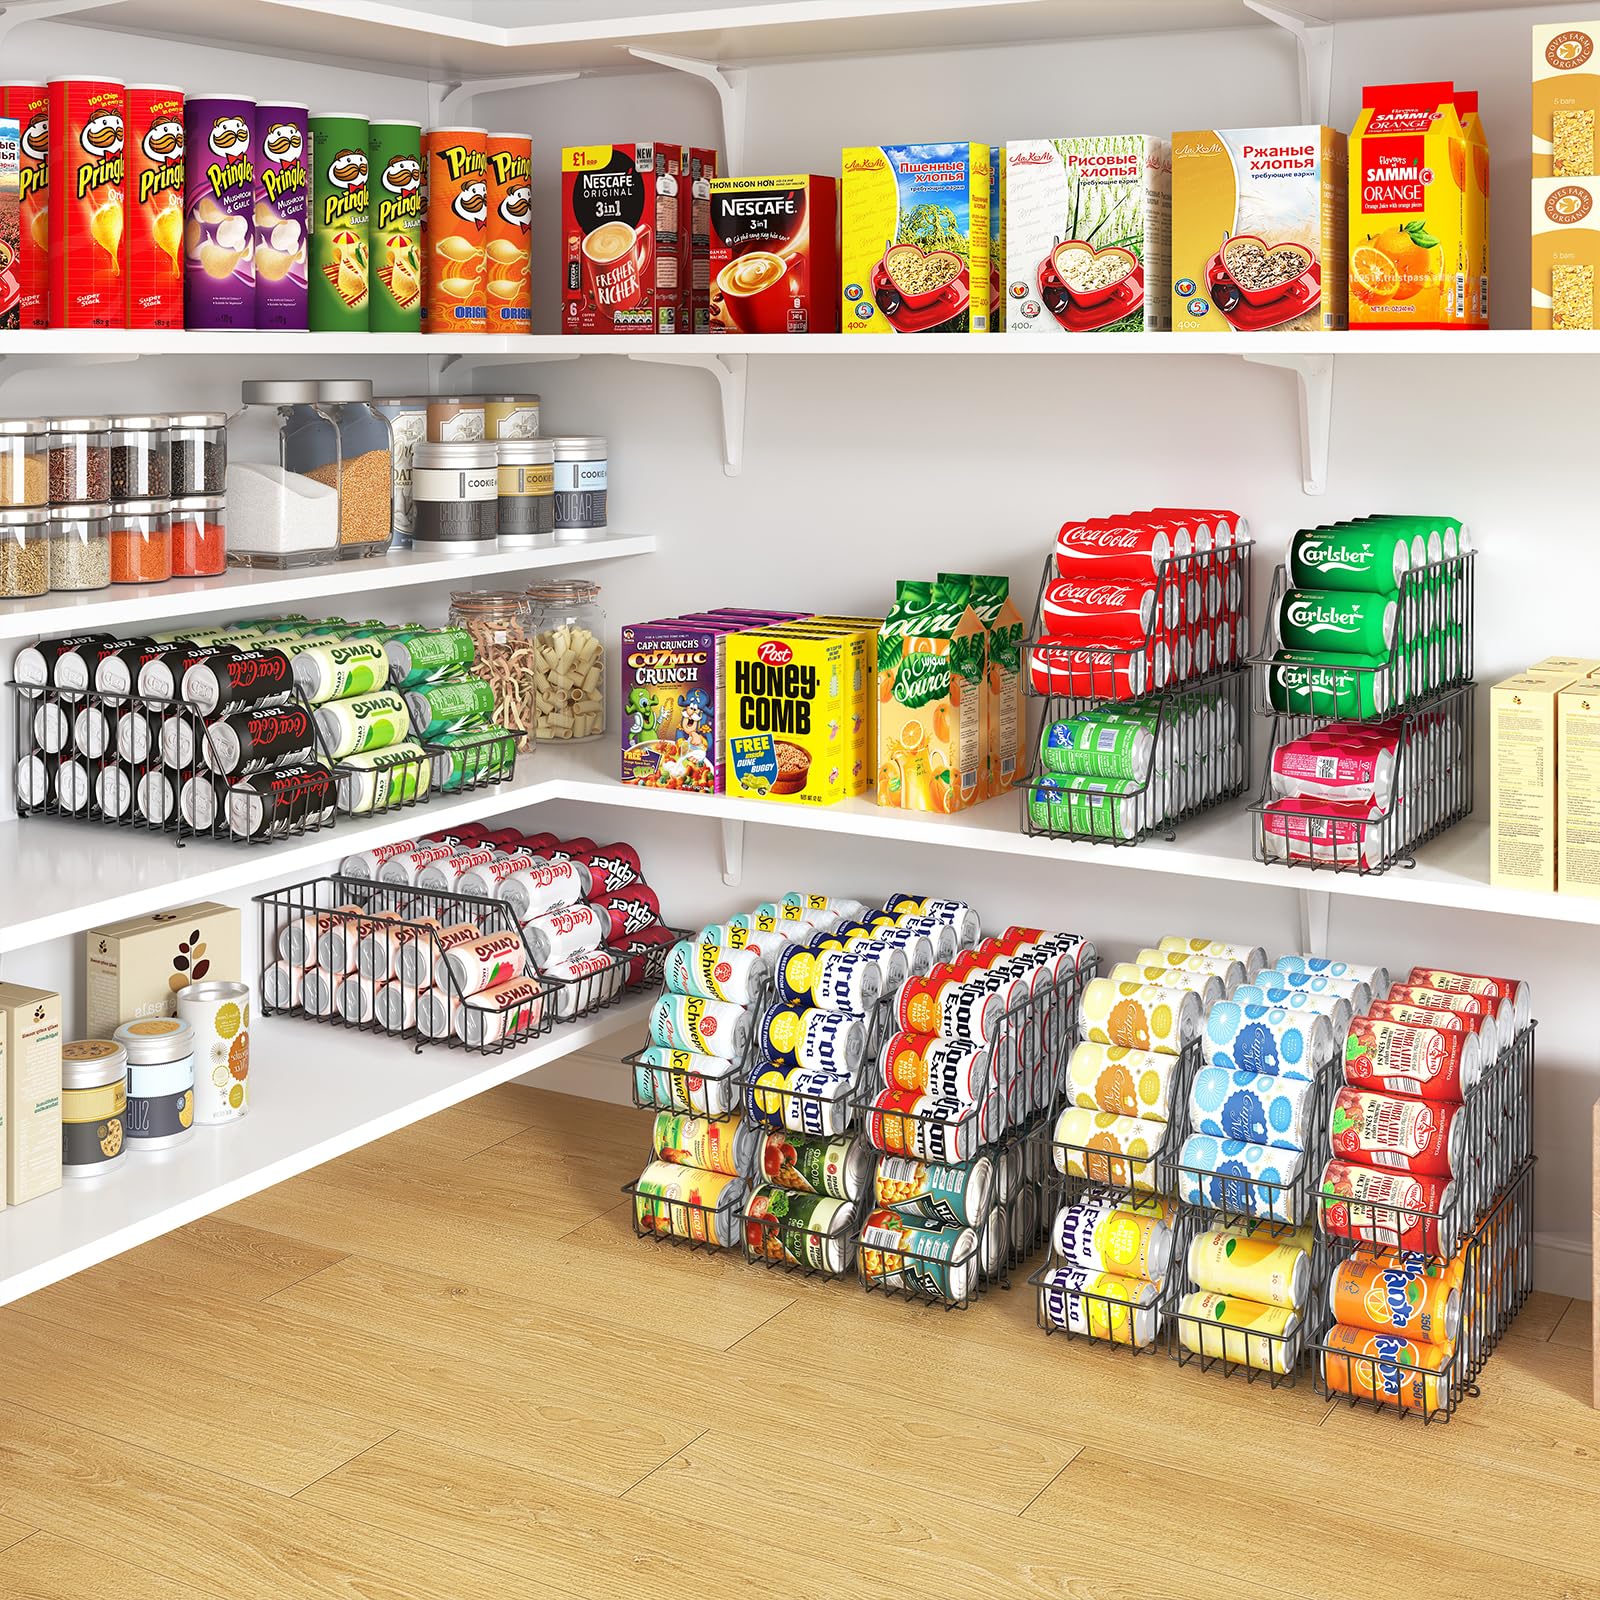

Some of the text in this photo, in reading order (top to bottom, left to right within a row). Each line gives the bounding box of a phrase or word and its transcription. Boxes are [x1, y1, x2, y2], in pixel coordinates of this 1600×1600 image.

[1548, 34, 1567, 58] DOVES
[1553, 50, 1590, 68] ORGANIC
[1370, 120, 1428, 129] ORANGE
[1376, 112, 1429, 121] SAMMI
[573, 152, 586, 166] £1
[637, 148, 652, 159] NEW
[1068, 155, 1137, 166] Рисовые
[1243, 146, 1314, 158] Ржаные
[446, 145, 487, 180] Pring
[491, 151, 531, 185] Pring
[900, 162, 964, 173] Пшенные
[1250, 159, 1314, 170] хлопья
[77, 153, 124, 199] Pringl
[139, 160, 184, 204] Pringl
[207, 154, 254, 198] Pringles
[262, 160, 307, 202] Pringles
[916, 173, 964, 183] хлопья
[1080, 168, 1137, 177] хлопья
[1366, 166, 1418, 182] SAMMI
[583, 188, 633, 198] ORIGINAL
[1364, 185, 1421, 202] ORANGE
[595, 201, 622, 217] 3in1
[1552, 203, 1589, 222] ORGANIC
[750, 219, 768, 229] 3in1
[596, 260, 634, 287] FRESHER
[598, 274, 640, 305] RICHER
[81, 298, 100, 308] Stack
[142, 299, 161, 308] Stack
[455, 307, 487, 318] ORIGIN
[570, 302, 577, 316] 6
[468, 480, 494, 488] COOKIE
[526, 475, 552, 484] COOKIE
[581, 471, 604, 479] COOKIE
[555, 493, 593, 521] SUGAR
[1063, 526, 1139, 549] Coca-Cola
[1050, 583, 1134, 608] Coca-Cola
[660, 639, 699, 649] CRUNCH'S
[760, 643, 792, 662] Post
[231, 650, 264, 662] zero
[628, 650, 707, 669] COZMIC
[227, 655, 287, 688] Coca-Cola
[636, 667, 698, 685] CRUNCH
[895, 666, 950, 703] Source
[252, 707, 285, 720] zero
[740, 696, 811, 735] COMB
[248, 712, 308, 746] Coca-Cola
[735, 736, 770, 754] FREE
[624, 750, 642, 761] FREE
[737, 758, 756, 767] DUNE
[274, 767, 307, 779] zero
[751, 763, 775, 774] BUGGY
[530, 860, 573, 888] Coca-Cola
[604, 874, 622, 893] Dr
[551, 907, 593, 936] Coca-Cola
[624, 916, 642, 935] Dr
[823, 953, 843, 998] Extra
[944, 993, 959, 1037] Extra
[807, 1012, 825, 1058] Extra
[1388, 1028, 1404, 1070] ТУШЕНАЯ
[1399, 1028, 1417, 1073] ГОВЯДИНА
[930, 1051, 946, 1096] Extra
[1358, 1058, 1370, 1078] 97,5%
[1377, 1101, 1393, 1145] ТУШЕНАЯ
[1387, 1102, 1405, 1147] ГОВЯДИНА
[1345, 1131, 1357, 1151] 97,5%
[811, 1148, 822, 1187] ФАСОЛЬ
[1383, 1268, 1416, 1328] Fanta
[1421, 1312, 1431, 1331] 350
[1413, 1380, 1423, 1399] 350
